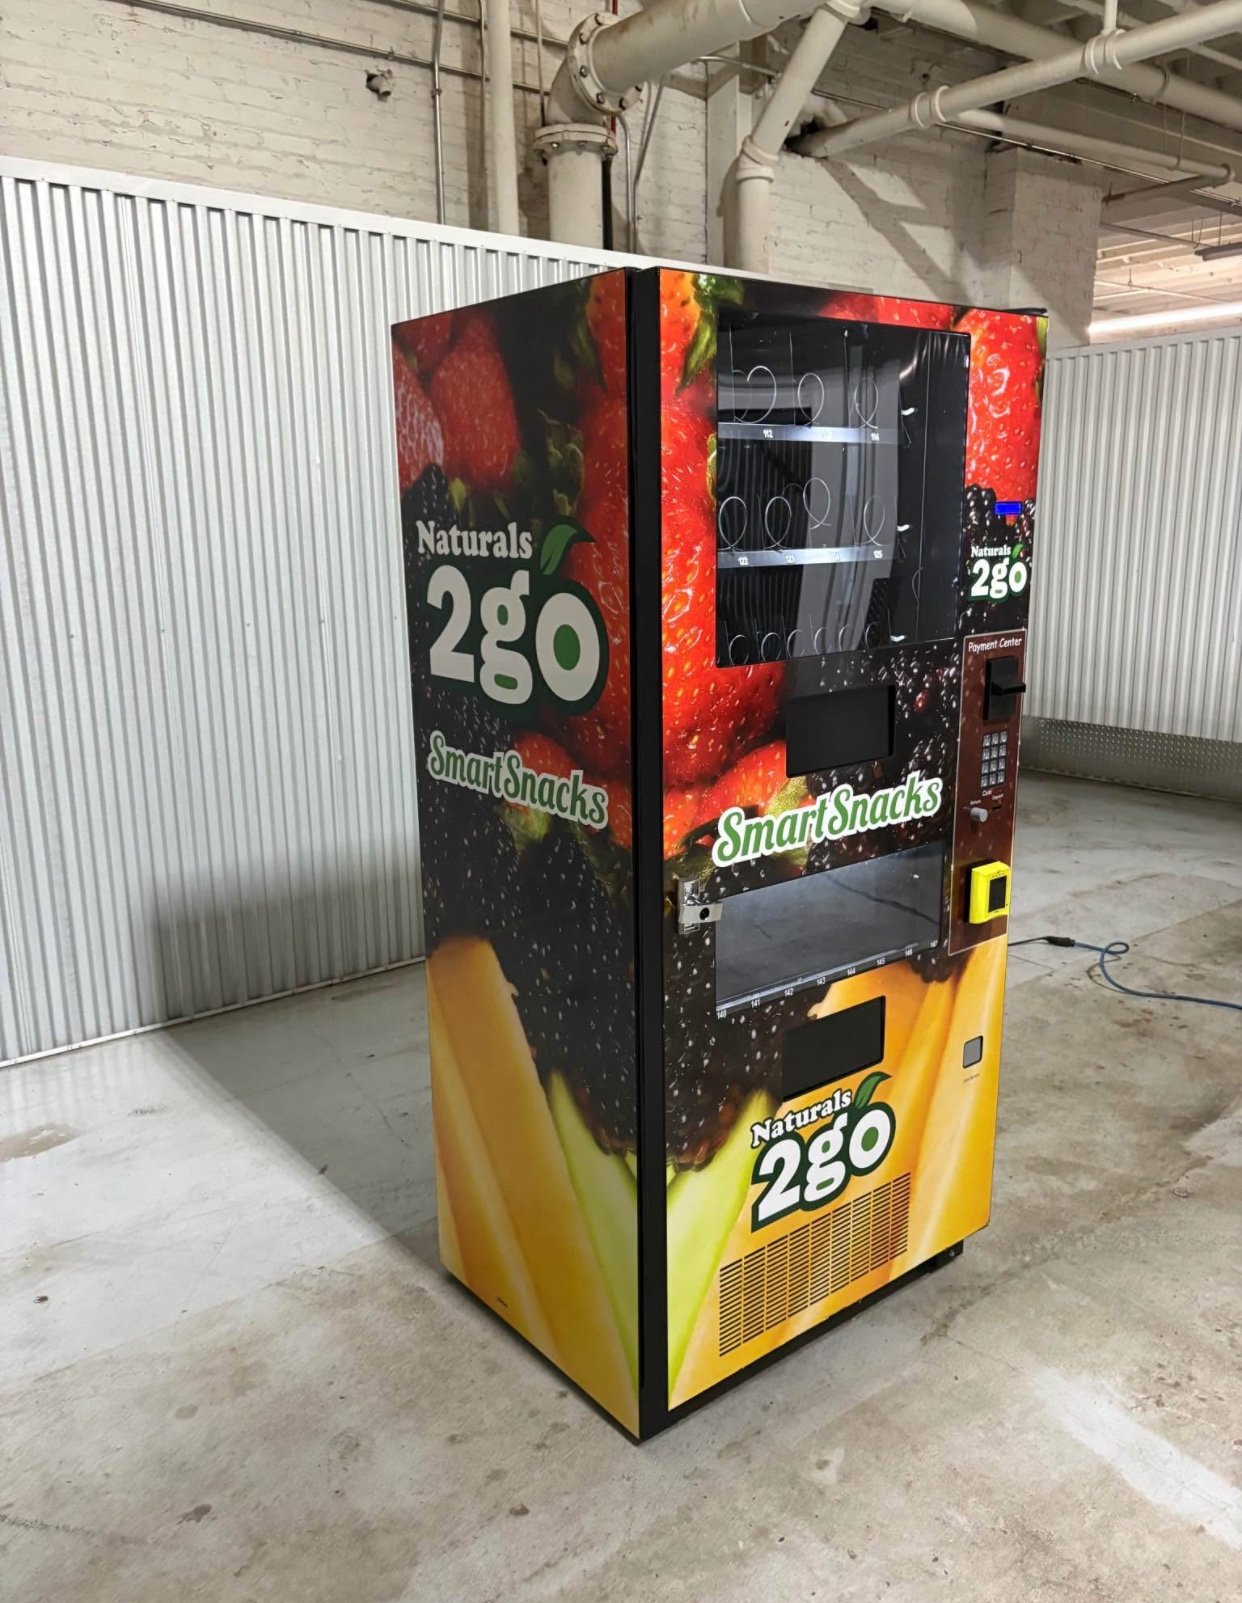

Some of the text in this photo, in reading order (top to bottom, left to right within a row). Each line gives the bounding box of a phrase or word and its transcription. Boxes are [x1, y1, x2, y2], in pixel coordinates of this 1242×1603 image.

[415, 520, 534, 560] Naturals
[970, 544, 1012, 558] Naturals
[970, 558, 1027, 599] 2go
[426, 564, 601, 705] 2go
[968, 638, 1022, 654] Payment Center
[428, 731, 608, 828] SmartSnacks
[713, 771, 943, 867] SmartSnacks
[783, 987, 794, 998] 142
[816, 976, 826, 986] 143
[751, 1088, 853, 1148] Naturals
[757, 1109, 892, 1222] 2go
